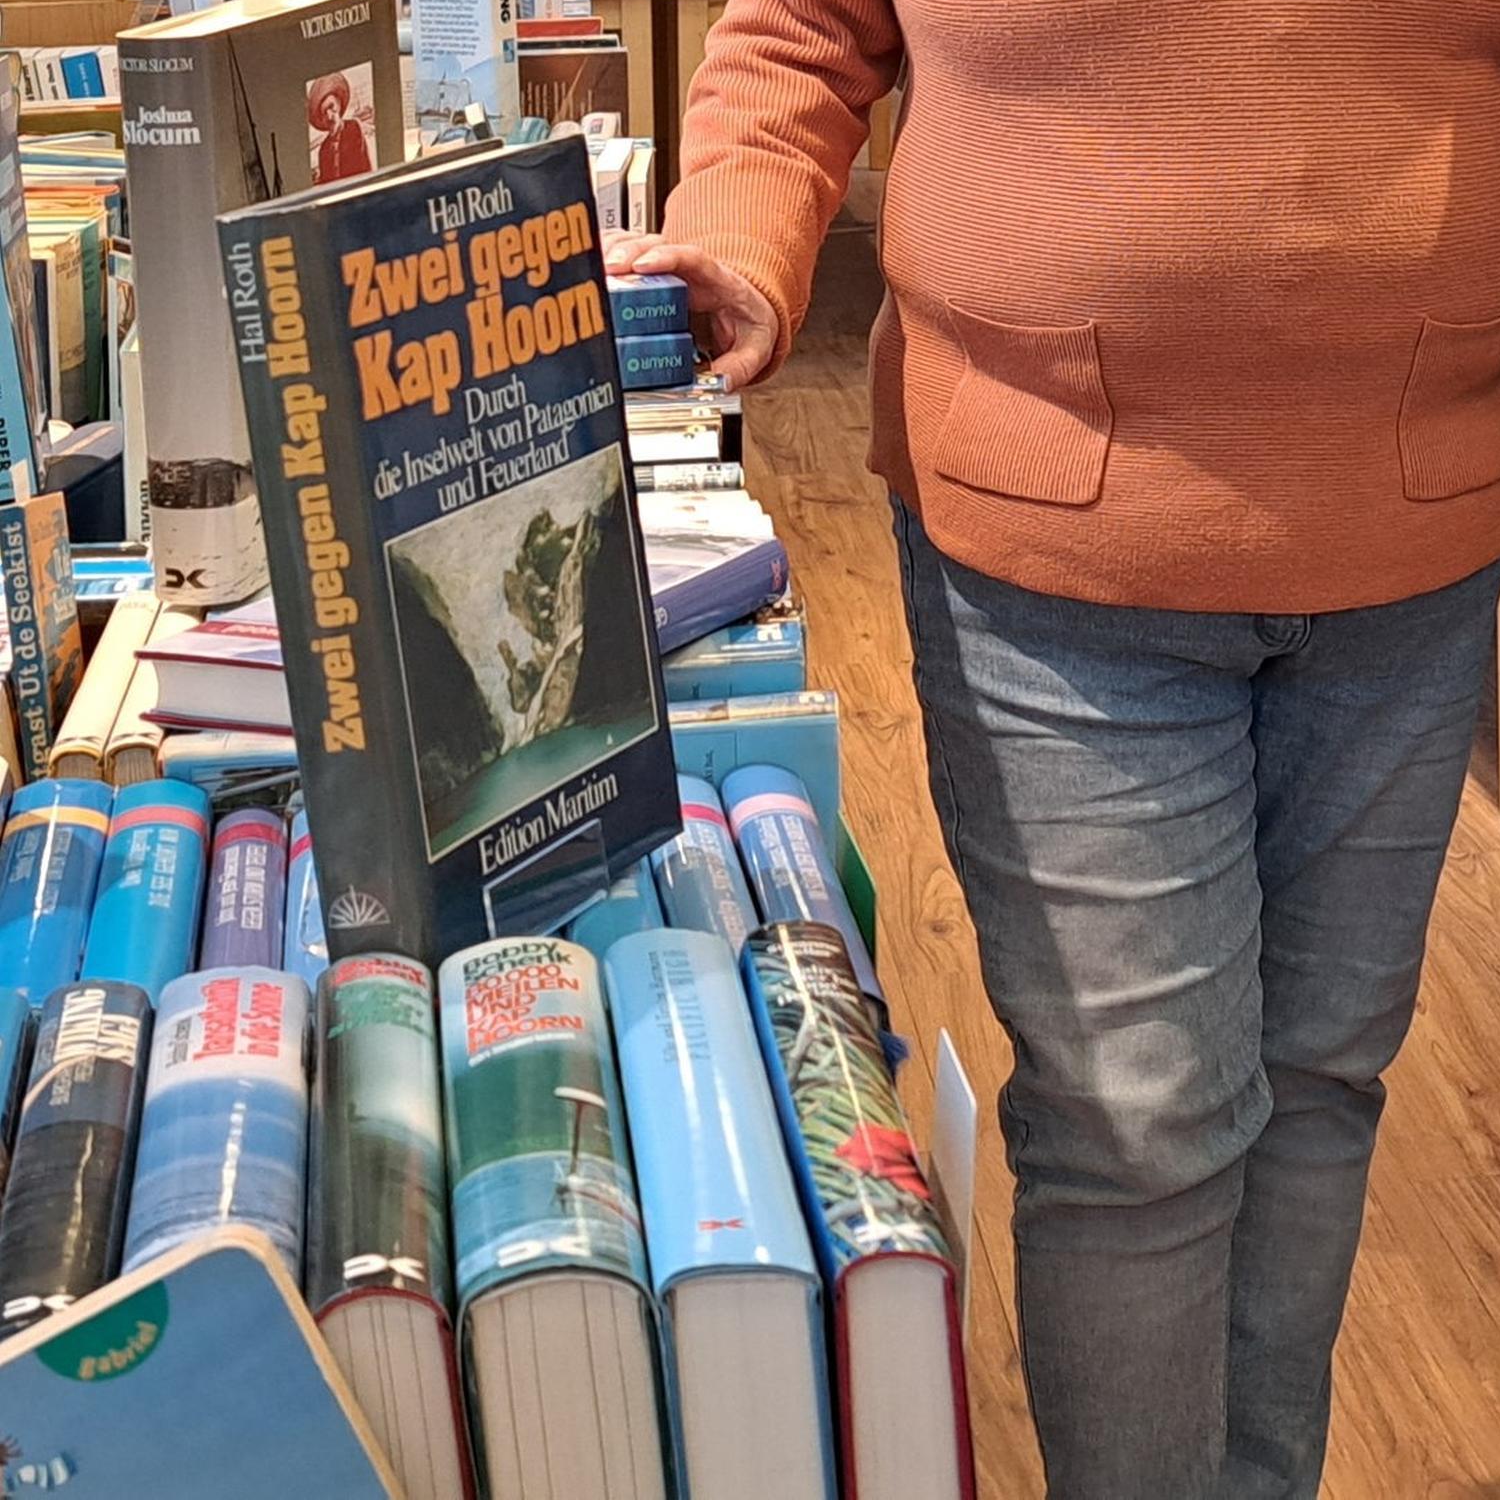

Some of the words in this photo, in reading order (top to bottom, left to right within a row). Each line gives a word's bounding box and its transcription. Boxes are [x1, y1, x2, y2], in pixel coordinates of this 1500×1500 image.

[300, 17, 334, 41] VICTOR
[333, 2, 372, 32] SLOCUM
[149, 56, 194, 73] SLOCUM
[123, 120, 201, 145] Slocum
[138, 106, 193, 127] Joshua
[428, 194, 465, 234] Hal
[466, 182, 514, 226] Roth
[226, 241, 257, 317] Roth
[341, 229, 464, 328] Zwei
[470, 202, 594, 294] gegen
[260, 235, 312, 379] Hoorn
[634, 303, 677, 319] KNAUR
[238, 320, 267, 365] Hal
[352, 323, 468, 421] Kap
[470, 279, 605, 380] Hoorn
[640, 354, 683, 370] KNAUR
[464, 377, 528, 425] Durch
[280, 383, 328, 479] Kap
[373, 461, 403, 501] die
[403, 419, 486, 490] Inselwelt
[486, 418, 521, 453] von
[524, 380, 615, 444] Patagonien
[437, 473, 476, 514] und
[480, 430, 571, 493] Feuerland
[2, 520, 34, 625] Seekist
[299, 487, 360, 629] gegen
[16, 627, 37, 669] de
[311, 633, 367, 754] Zwei
[479, 811, 545, 875] Edition
[543, 772, 619, 843] Maritim
[462, 941, 560, 977] Bobby
[466, 976, 580, 1008] MEILEN
[469, 1016, 585, 1056] HOORN
